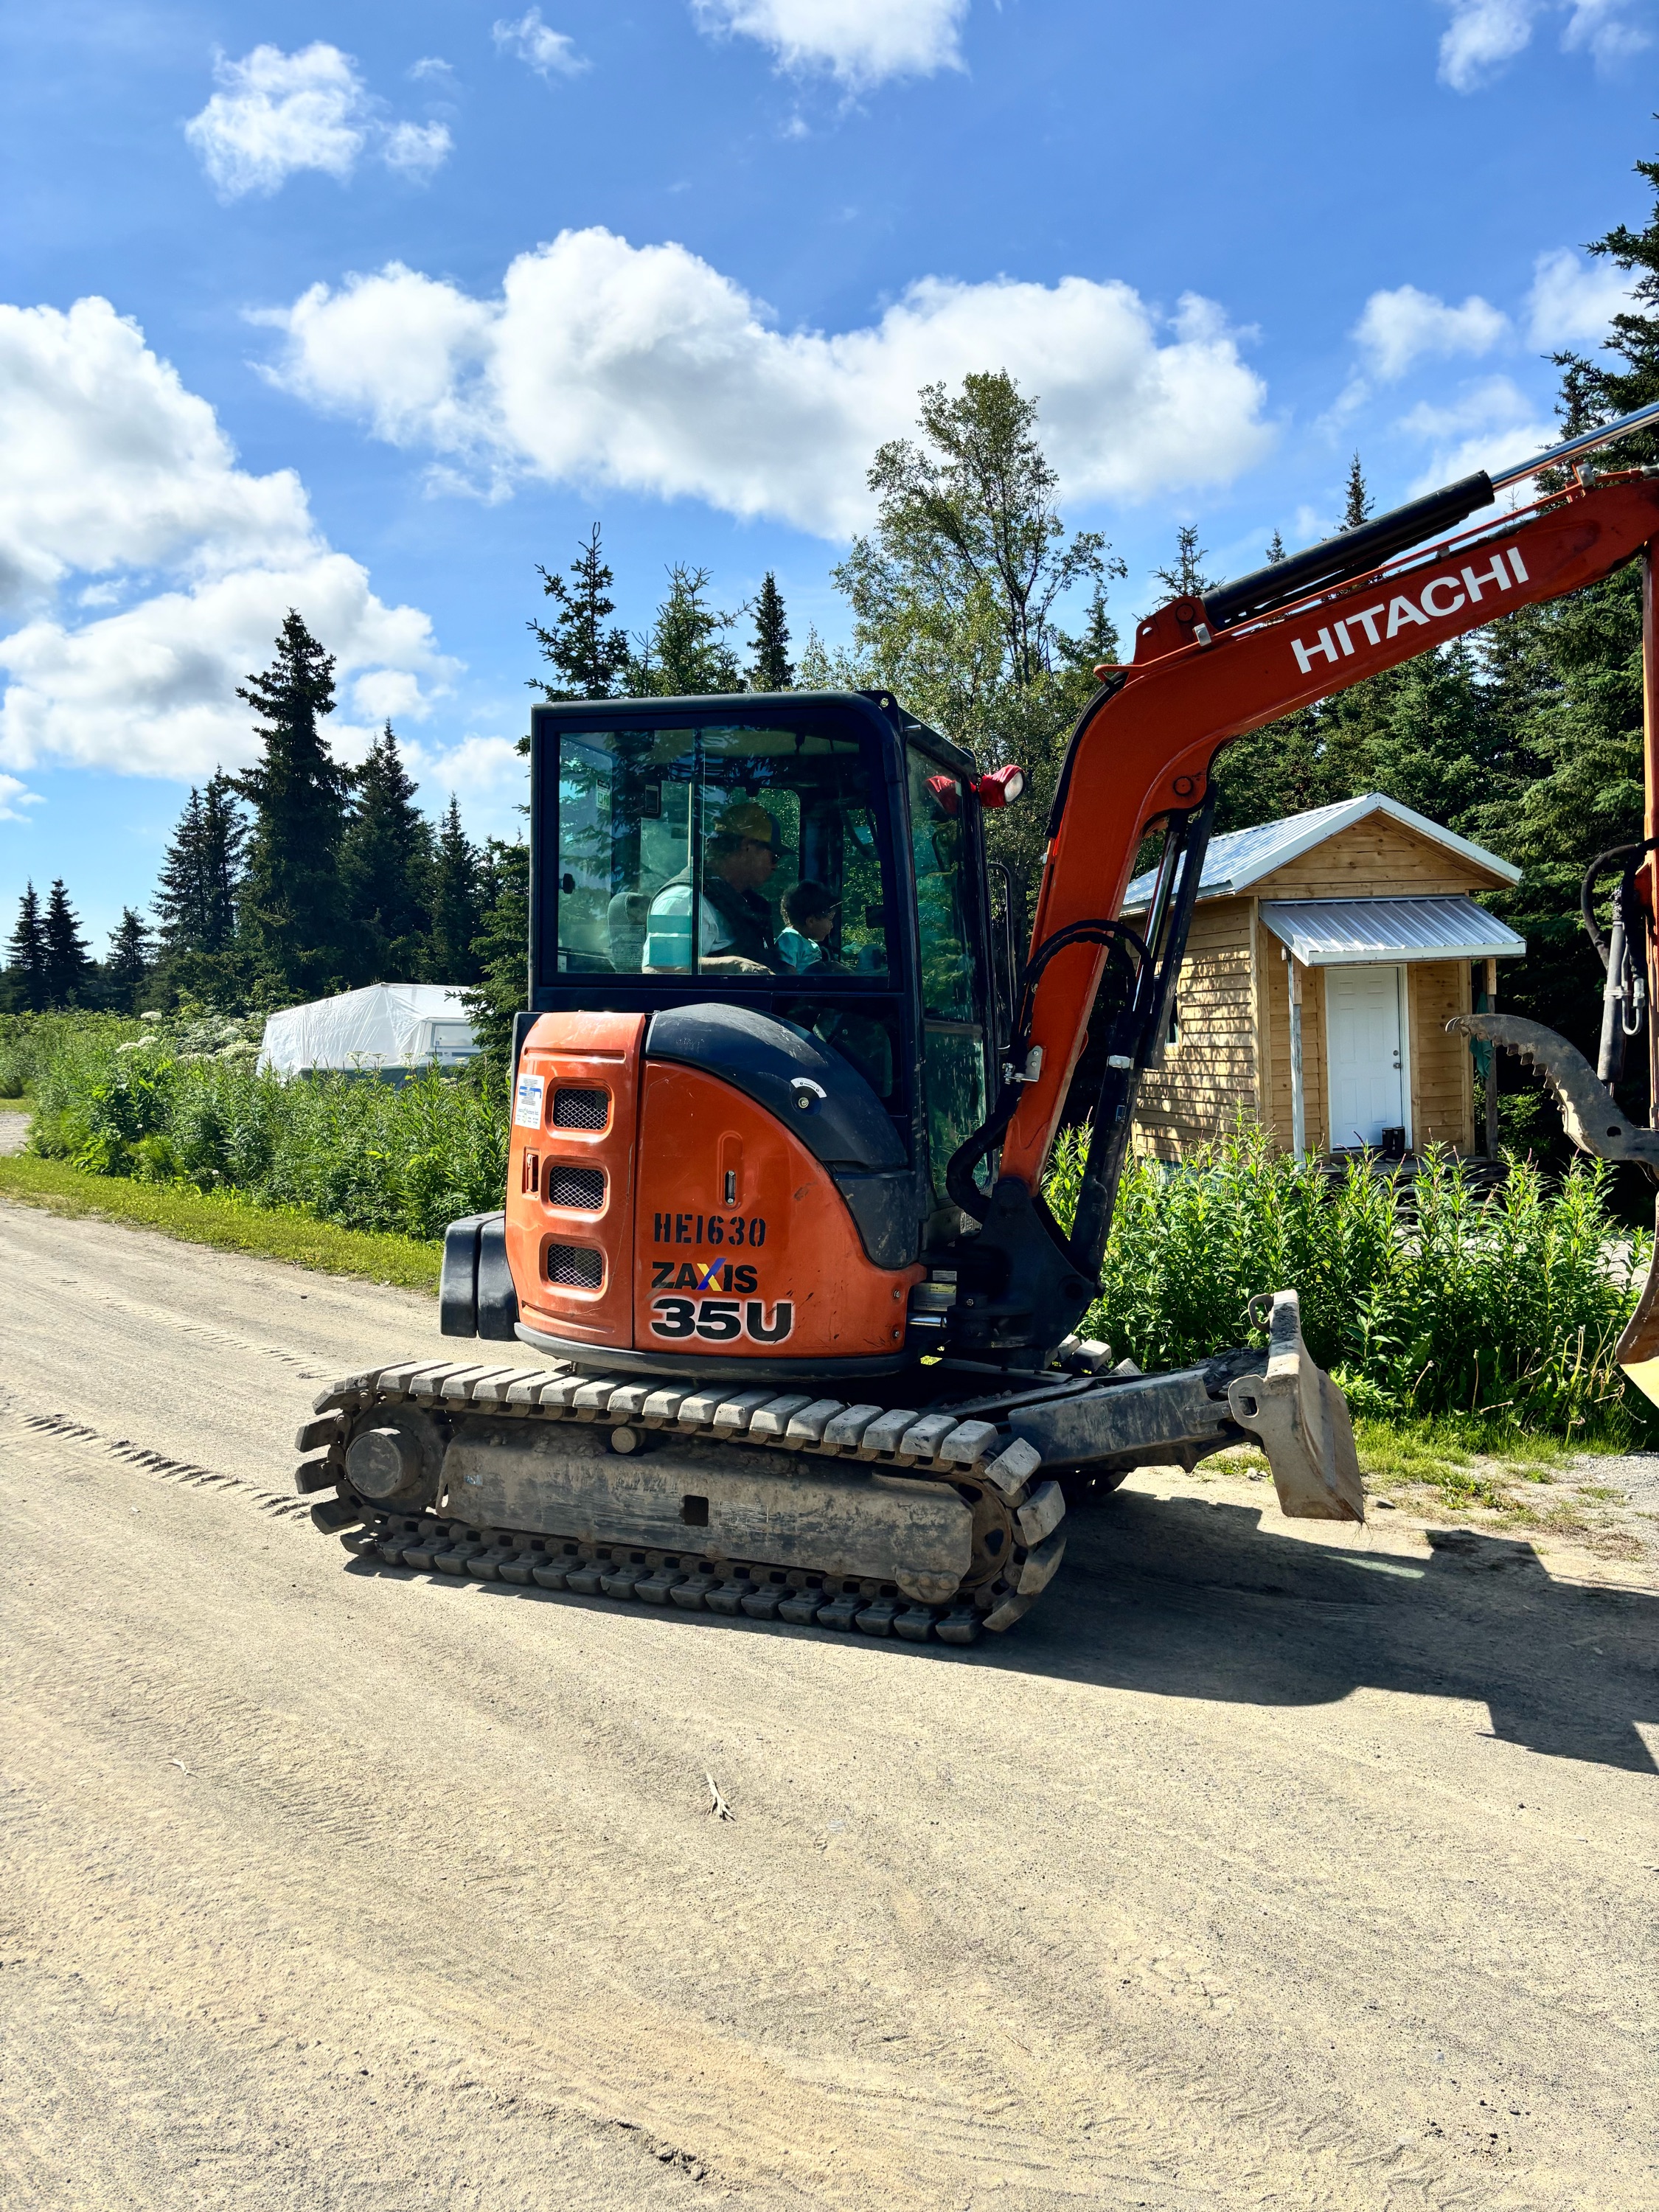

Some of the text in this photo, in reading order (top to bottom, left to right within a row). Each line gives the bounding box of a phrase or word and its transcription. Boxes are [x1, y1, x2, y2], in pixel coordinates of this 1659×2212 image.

[1290, 546, 1529, 674] HITACHI
[654, 1213, 766, 1248] HE1630
[652, 1257, 758, 1294] ZAXIS
[651, 1298, 793, 1342] 35U
